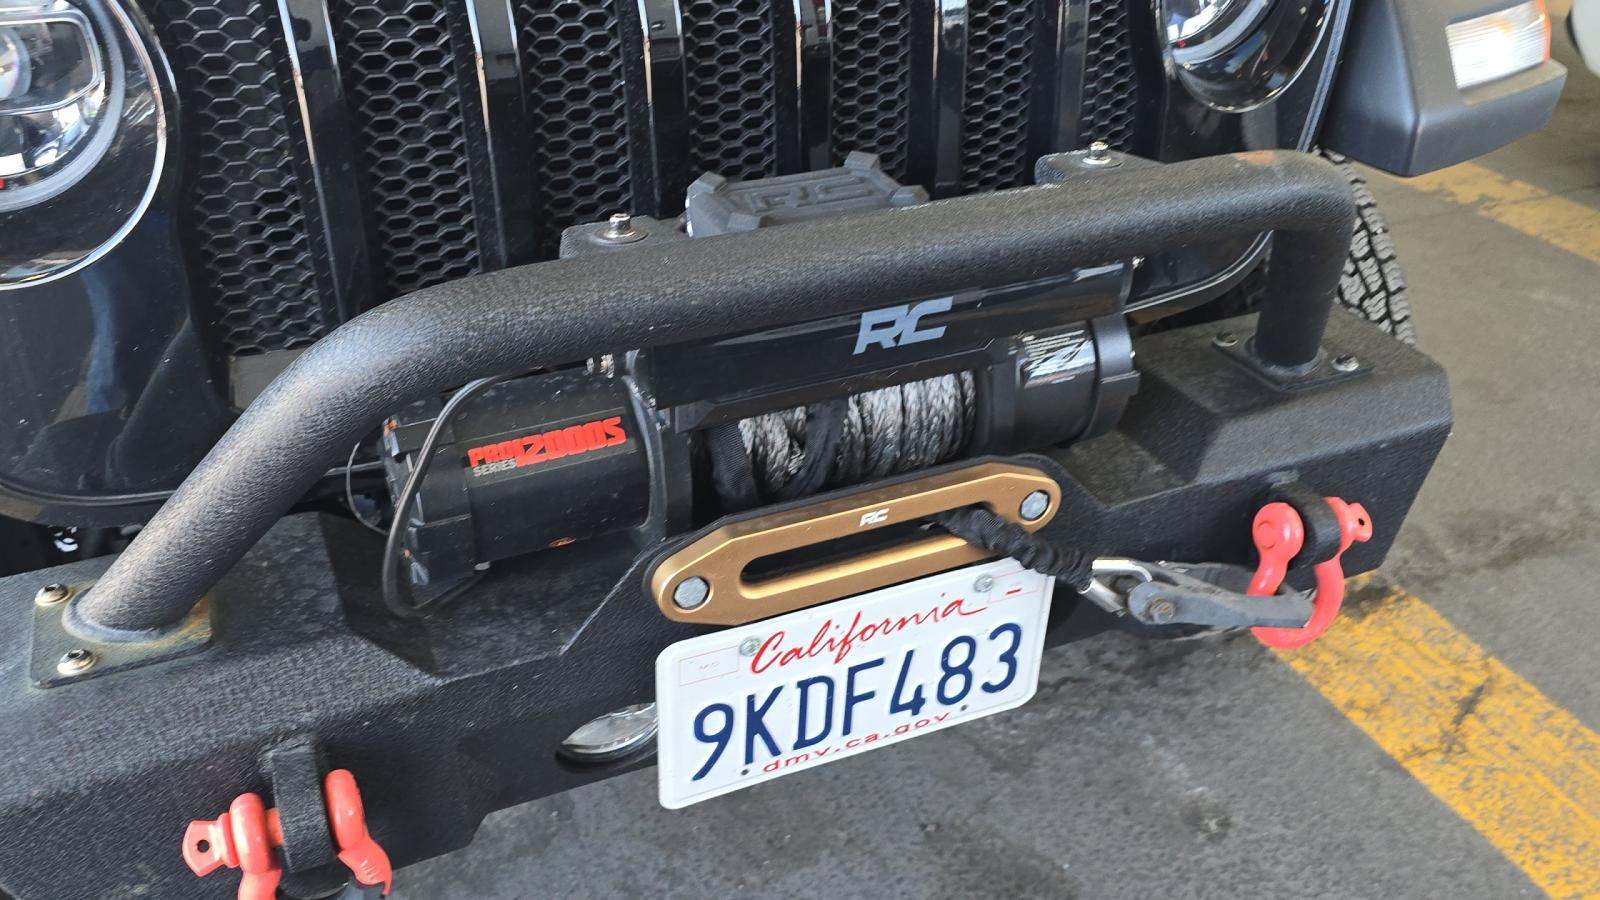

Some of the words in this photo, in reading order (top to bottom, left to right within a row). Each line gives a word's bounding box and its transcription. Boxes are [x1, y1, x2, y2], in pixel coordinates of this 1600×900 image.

[853, 296, 954, 355] RC
[473, 459, 518, 477] SERIES
[859, 508, 890, 527] RC
[751, 593, 988, 675] California
[692, 622, 1023, 781] 9KDF483
[762, 712, 950, 774] dmv.ca.gov
